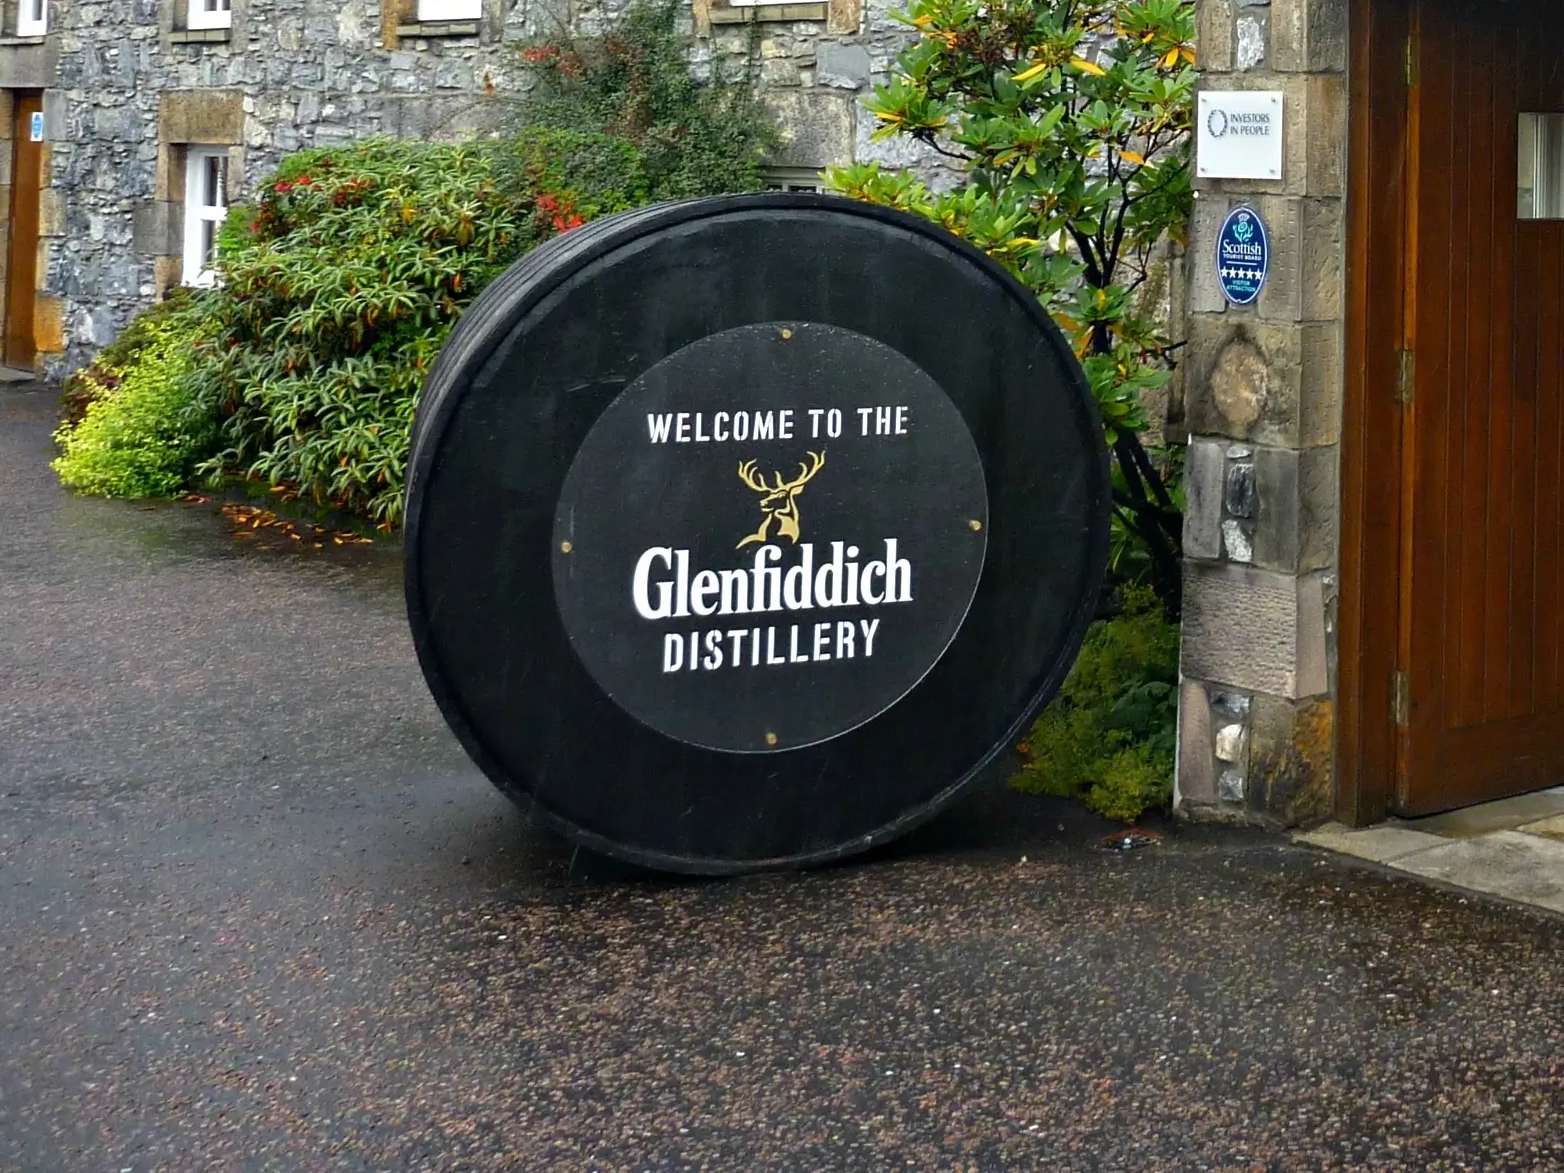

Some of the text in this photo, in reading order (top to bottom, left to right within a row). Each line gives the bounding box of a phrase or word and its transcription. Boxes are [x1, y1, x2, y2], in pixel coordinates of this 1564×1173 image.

[1230, 113, 1270, 123] INVESTORS
[1230, 125, 1270, 135] IN PEOPLE
[1222, 239, 1262, 255] Scottish
[647, 406, 909, 444] WELCOME TO THE
[632, 538, 913, 620] Glenfiddich
[663, 619, 880, 673] DISTILLERY
